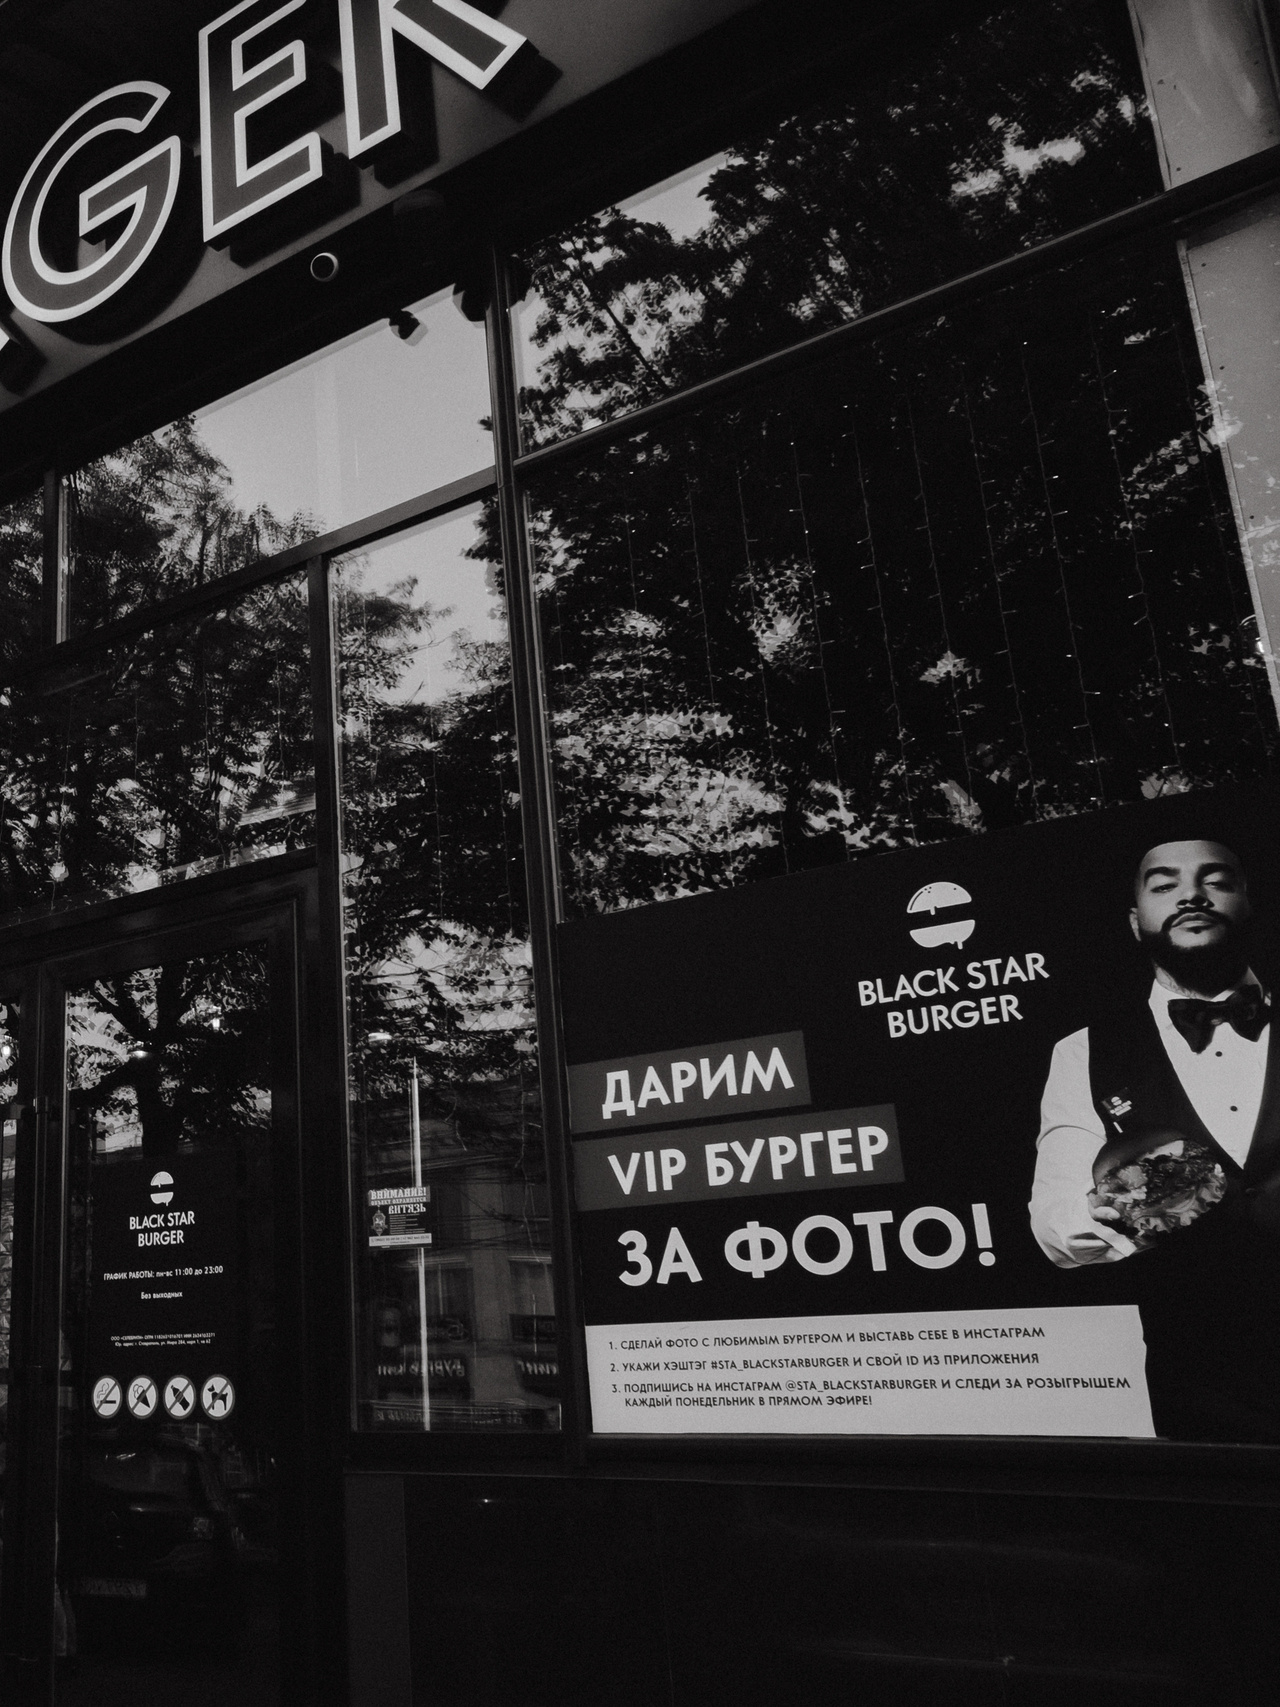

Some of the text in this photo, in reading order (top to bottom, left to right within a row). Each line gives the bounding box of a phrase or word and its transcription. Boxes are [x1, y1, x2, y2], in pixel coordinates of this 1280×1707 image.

[857, 952, 1051, 1008] BLACK STAR
[887, 994, 1023, 1038] BURGER
[601, 1046, 795, 1119] ДАРИМ
[608, 1125, 890, 1196] VIP БУРГЕР
[371, 1187, 426, 1200] ВНИМАНИЕ!
[129, 1211, 195, 1230] BLACK STAR
[138, 1230, 184, 1247] BURGER
[617, 1202, 997, 1287] ЗА ФОТО!
[104, 1272, 128, 1280] ГРАФИК
[129, 1270, 155, 1279] РАБОТЫ:
[204, 1265, 224, 1274] 23:00
[153, 1291, 183, 1299] выходных
[609, 1327, 1045, 1350] 1. СДЕЛАЙ ФОТО С ЛЮБИМЫМ БУРГЕРОМ И ВЫСТАВЬ СЕБЕ В ИНСТАГРАМ
[611, 1353, 1039, 1372] 2. УКАЖИ ХЭШТЭГ #STA_BLACKSTARBURGER И СВОЙ ID ИЗ ПРИЛОЖЕНИЯ
[612, 1377, 1131, 1393] 3. ПОДПИШИСЬ НА ИНСТАГРАМ @STA_BLACKSTARBURGER И СЛЕДИ ЗА РОЗЫГРЫШЕМ
[625, 1395, 872, 1408] КАЖДЫЙ ПОНЕДЕЛЬНИК В ПРЯМОМ ЭФИРЕ!
